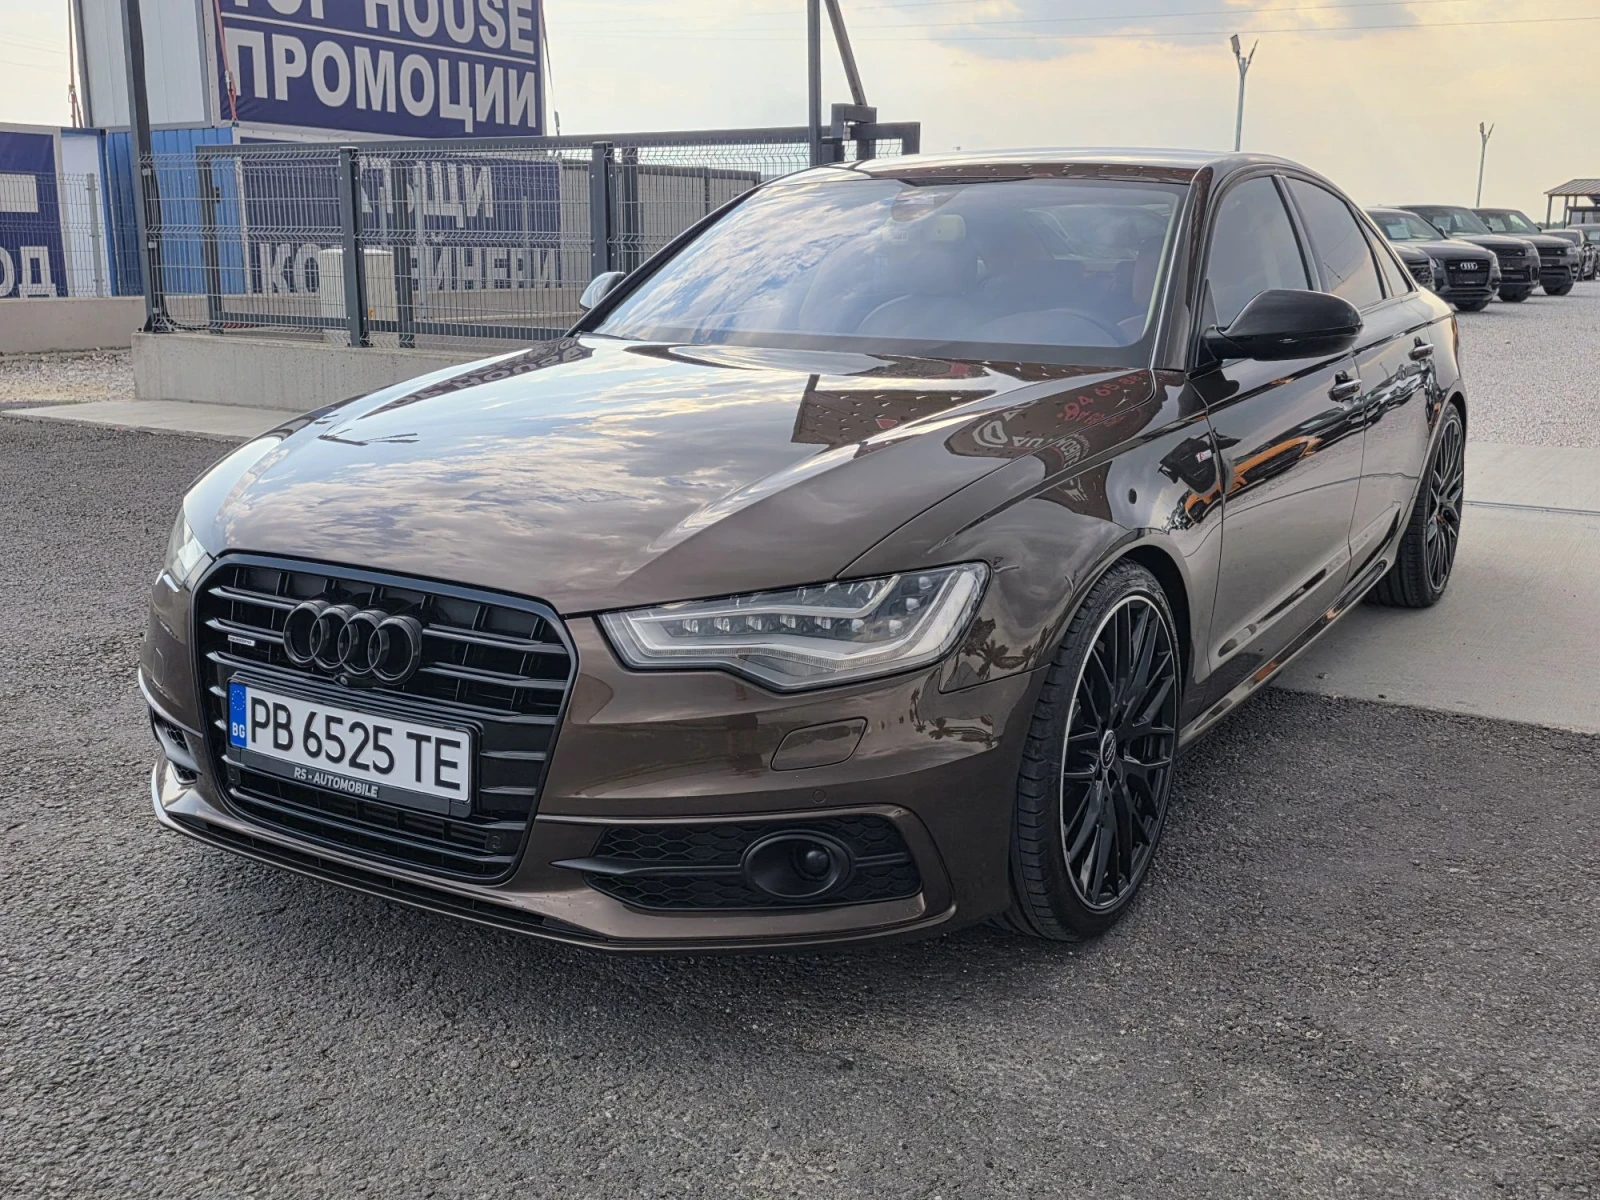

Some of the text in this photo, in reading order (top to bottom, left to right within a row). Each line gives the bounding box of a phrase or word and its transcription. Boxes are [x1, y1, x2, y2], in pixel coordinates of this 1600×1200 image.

[224, 27, 536, 133] ПРОМОЦИИ
[232, 722, 246, 738] BG
[251, 696, 461, 791] PB 6525 TE
